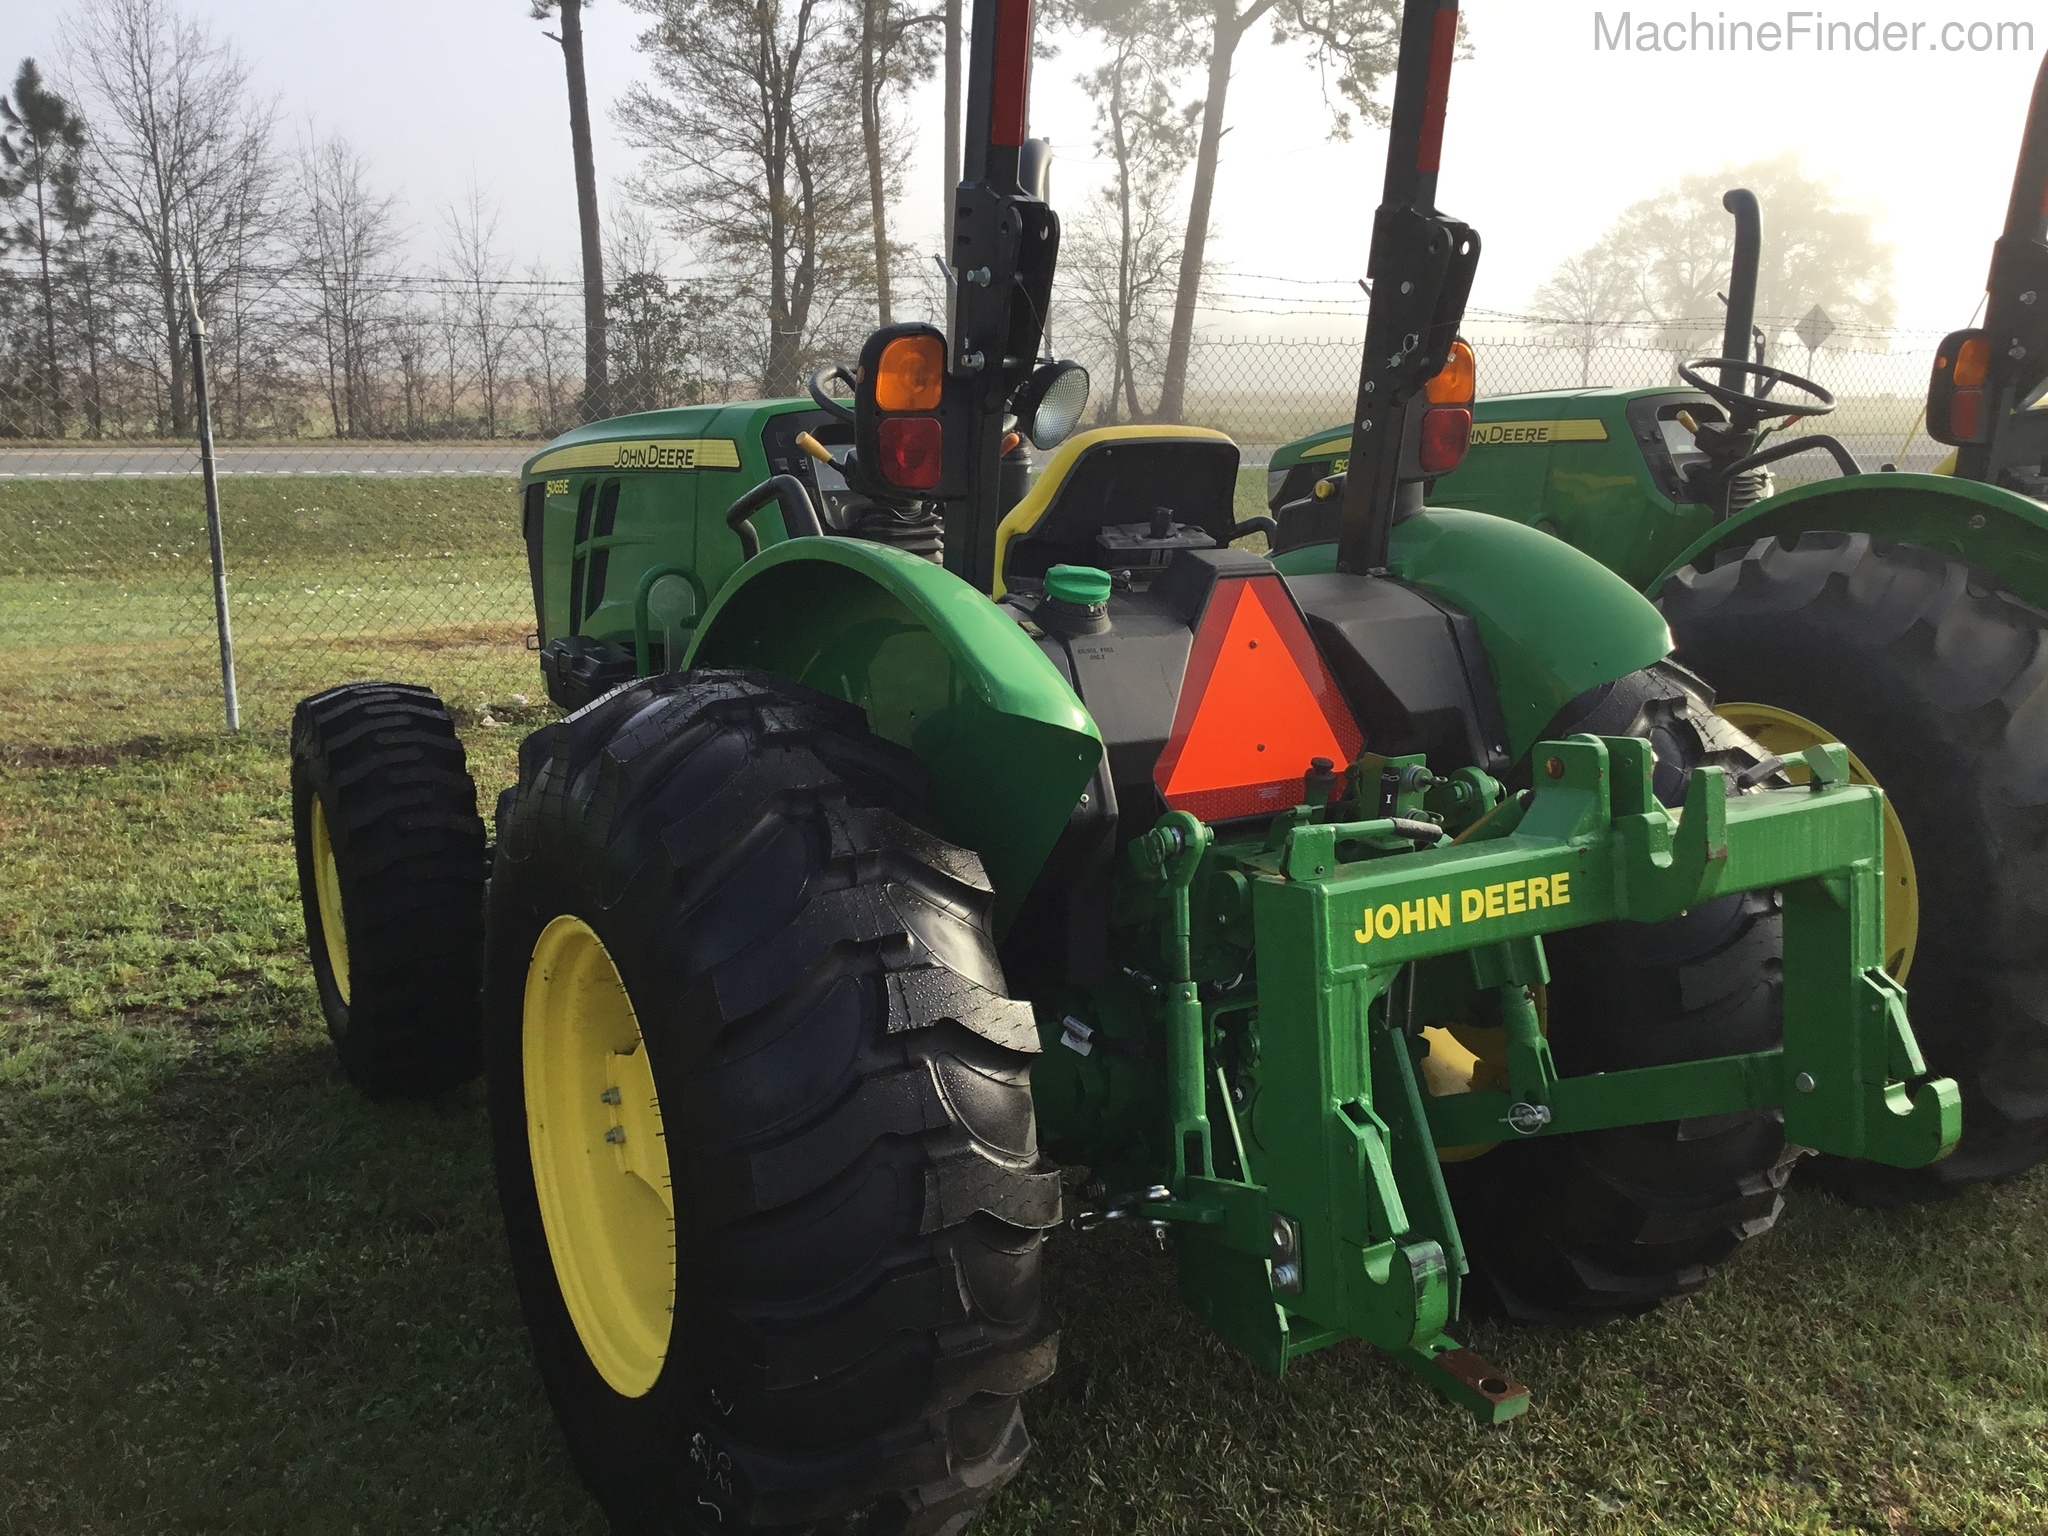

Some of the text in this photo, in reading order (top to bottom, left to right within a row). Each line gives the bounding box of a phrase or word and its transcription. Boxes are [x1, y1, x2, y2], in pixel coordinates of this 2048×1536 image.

[1490, 426, 1548, 441] DEERE
[614, 445, 694, 466] JOHN DEERE
[1354, 871, 1570, 944] JOHN DEERE
